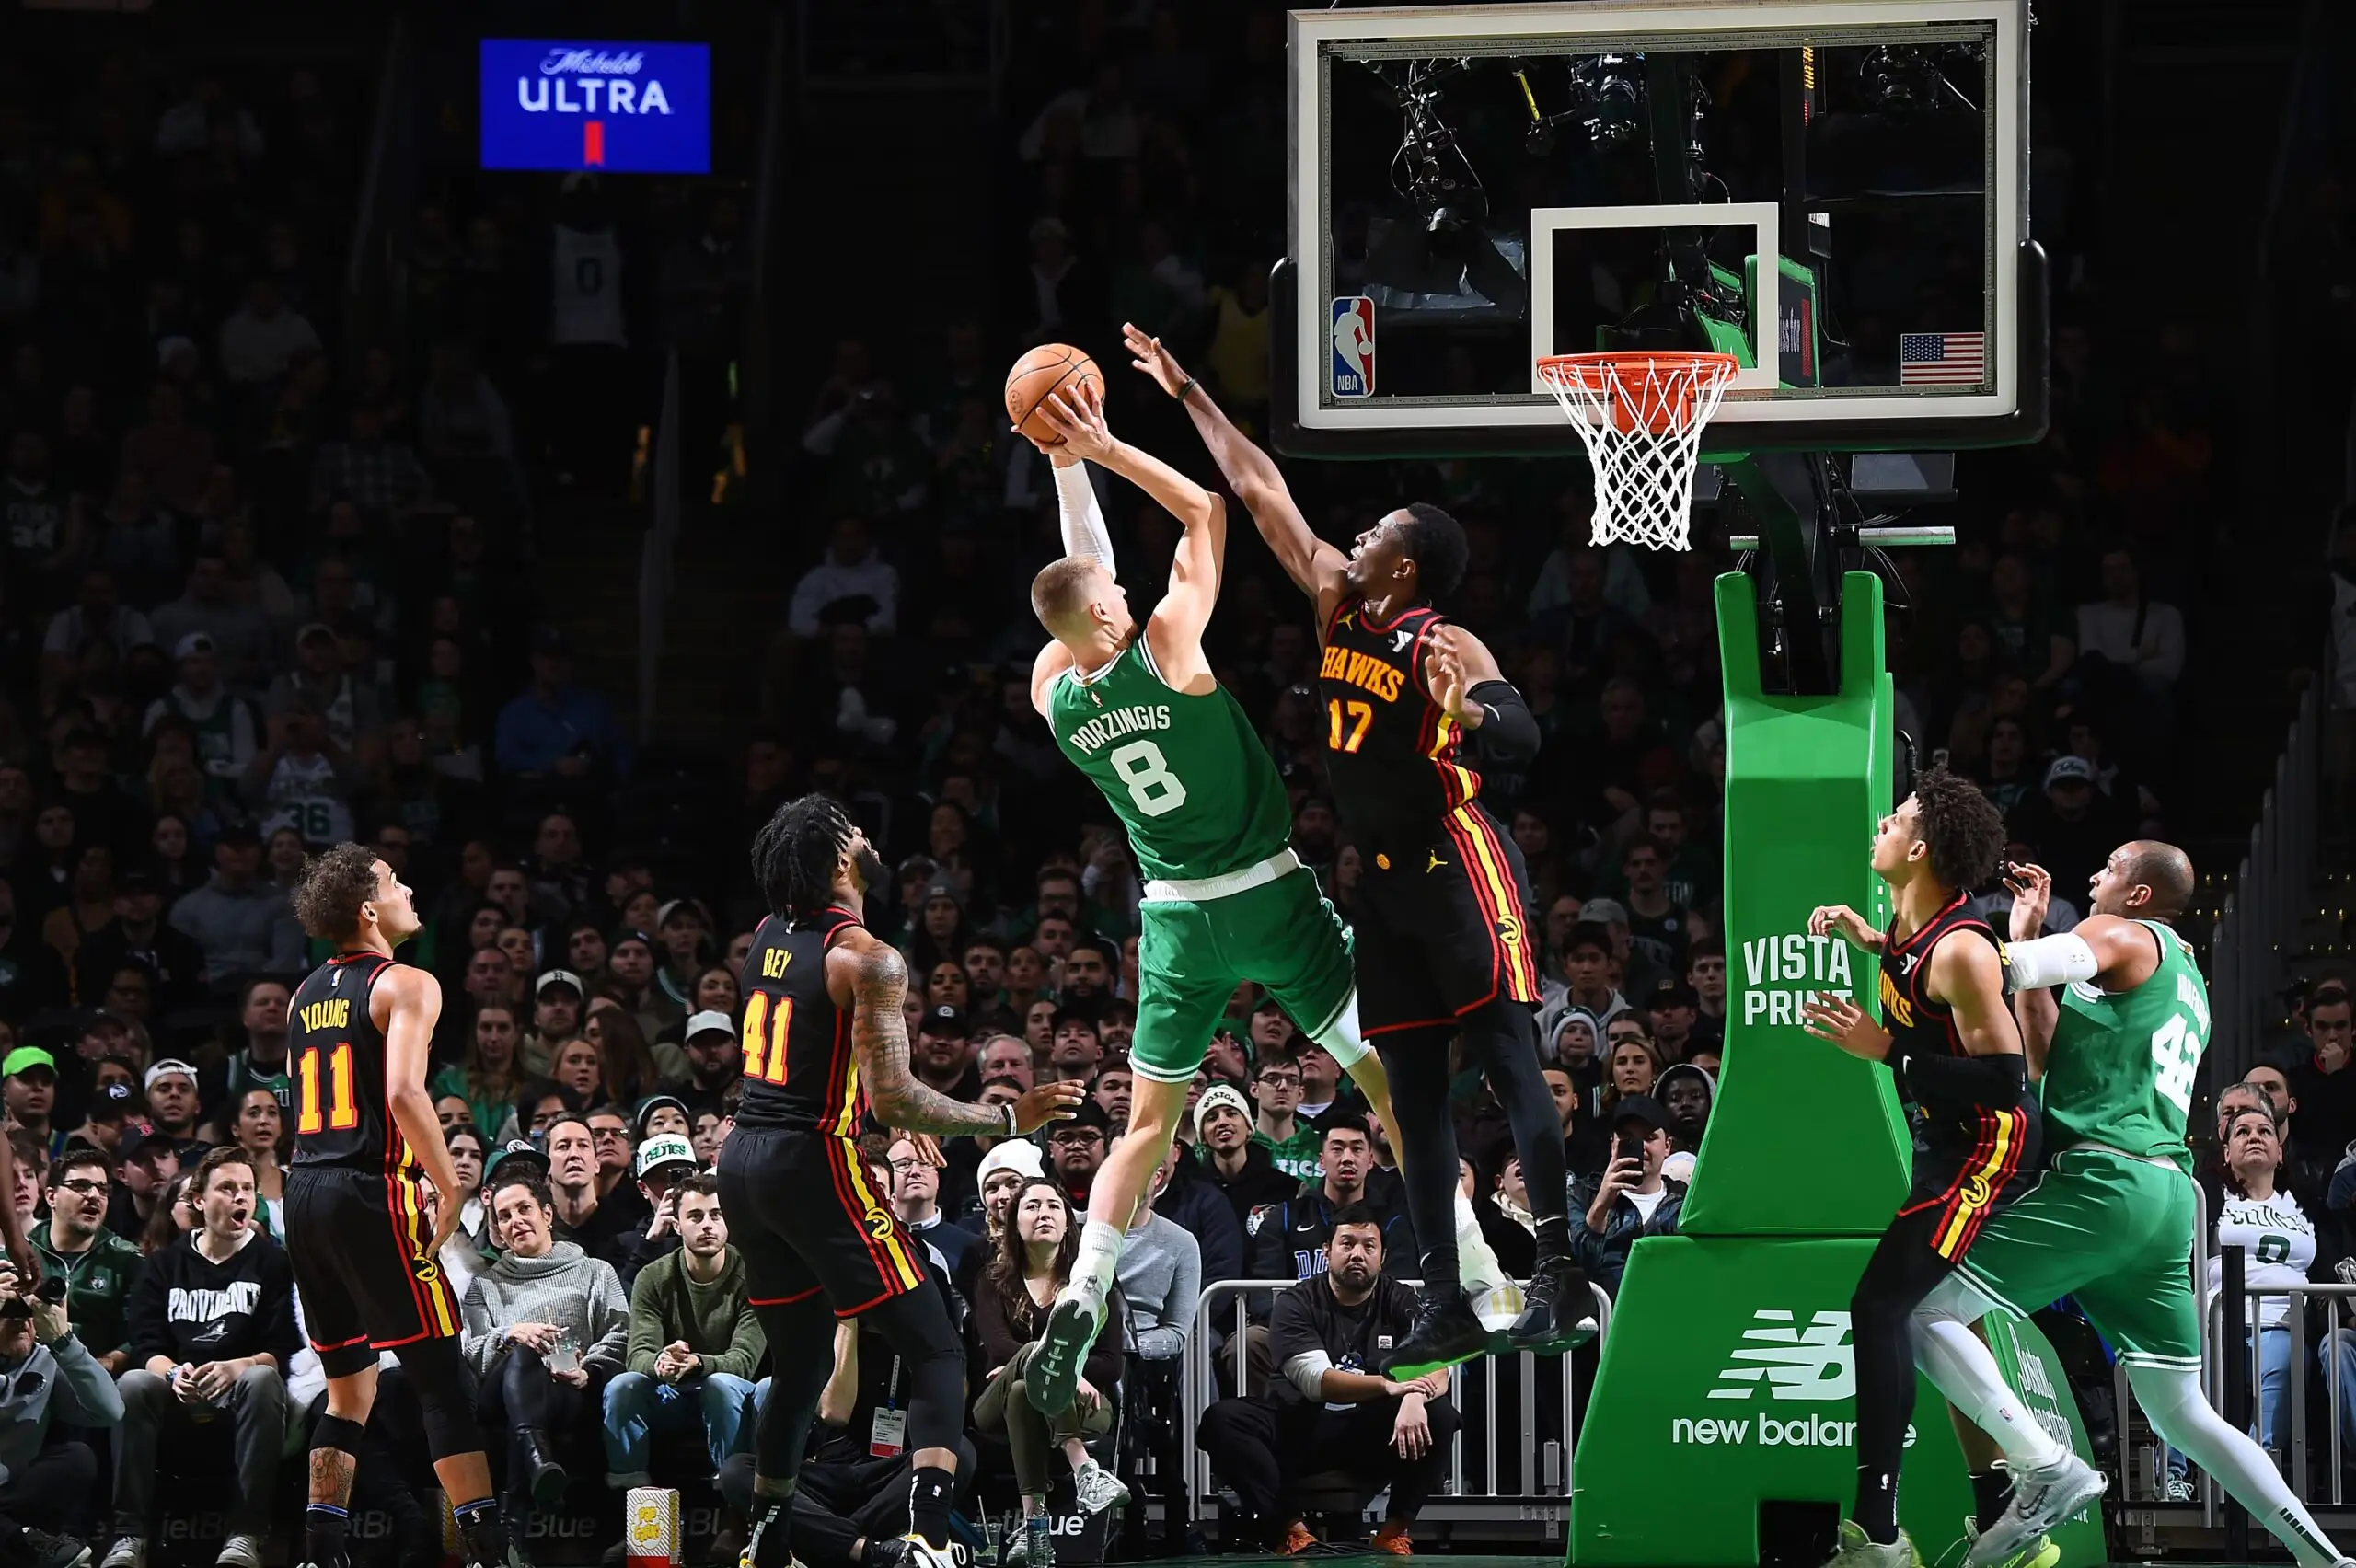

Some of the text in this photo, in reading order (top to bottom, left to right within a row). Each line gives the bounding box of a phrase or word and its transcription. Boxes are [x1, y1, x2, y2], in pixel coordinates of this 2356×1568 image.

[518, 76, 671, 115] ULTRA
[1337, 375, 1358, 391] NBA
[1320, 646, 1405, 703] HAWKS
[1068, 705, 1171, 756] PORZINGIS
[1329, 698, 1372, 754] 17
[1110, 739, 1187, 817] 8
[762, 948, 792, 979] BEY
[1743, 934, 1853, 986] VISTA
[299, 998, 350, 1034] YOUNG
[742, 989, 793, 1086] 41
[298, 1042, 358, 1135] 11
[1203, 1091, 1237, 1108] BOSTON
[645, 1143, 686, 1165] CELTICS
[1276, 1159, 1327, 1178] TICS
[2255, 1234, 2291, 1264] 0
[1672, 1412, 1917, 1448] new balane
[160, 1510, 229, 1541] jetB
[524, 1511, 596, 1538] Blue
